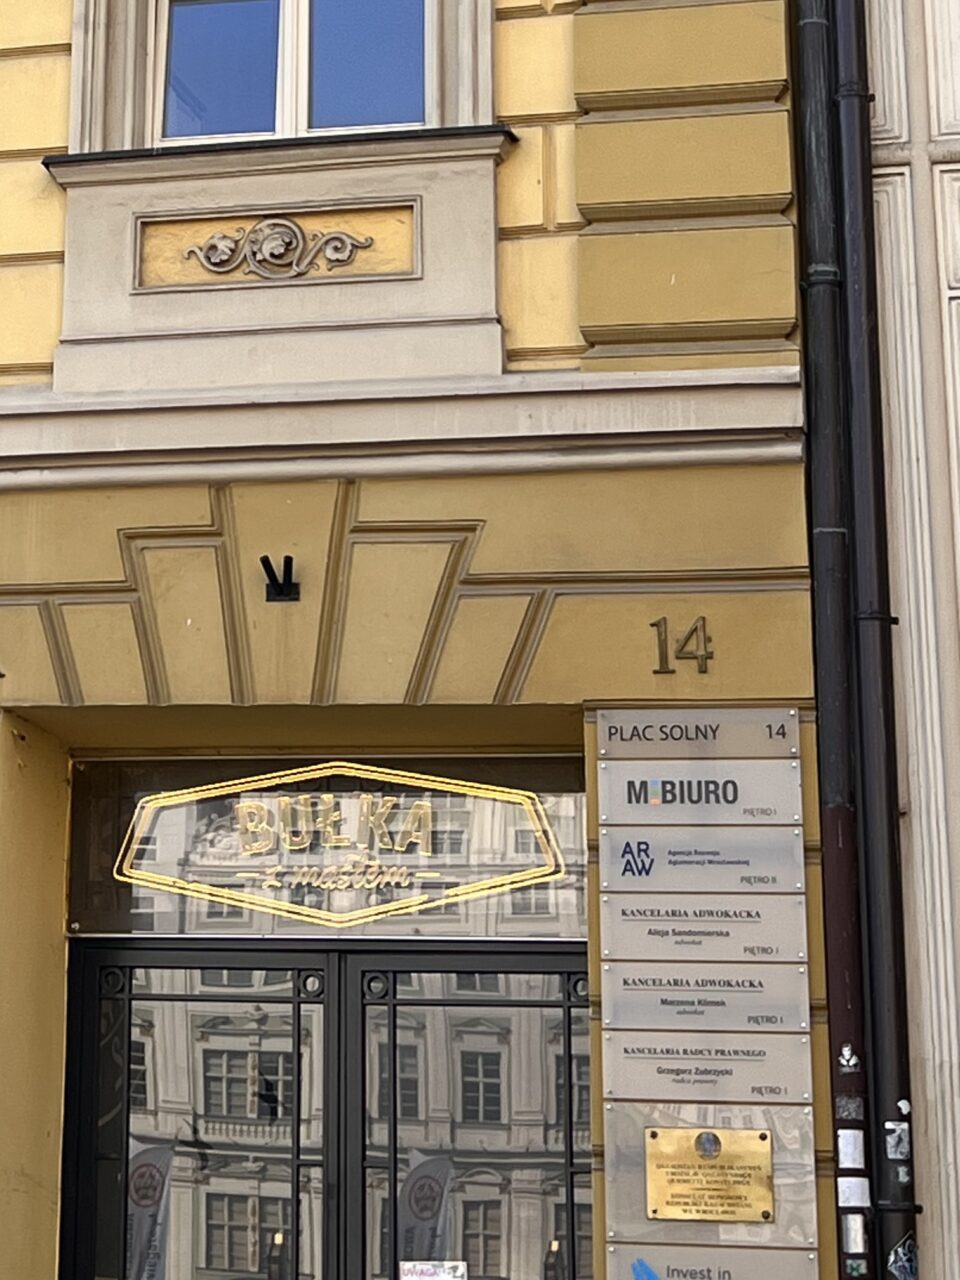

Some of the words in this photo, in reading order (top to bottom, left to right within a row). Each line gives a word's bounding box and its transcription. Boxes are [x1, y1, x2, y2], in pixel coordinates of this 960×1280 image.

[649, 616, 714, 674] 14
[608, 725, 654, 741] PLAC
[659, 724, 720, 741] SOLNY
[765, 724, 787, 739] 14
[235, 794, 432, 857] BUŁKA
[621, 841, 650, 859] AR
[621, 858, 654, 877] AW
[740, 876, 770, 886] PIĘTRO
[621, 908, 688, 918] KANCELARIA
[692, 909, 761, 919] ADWOKACKA
[671, 928, 730, 938] Sandomierska
[743, 946, 773, 956] PIĘTRO
[622, 977, 690, 988] KANCELARIA
[694, 978, 764, 989] ADWOKACKA
[747, 1015, 777, 1026] PIĘTRO
[624, 1047, 680, 1055] KANCELARIA
[682, 1048, 713, 1056] RADCY
[714, 1049, 766, 1057] PRAWNEGO
[751, 1086, 781, 1096] PIĘTRO
[666, 1265, 718, 1279] Invest
[722, 1266, 732, 1280] in
